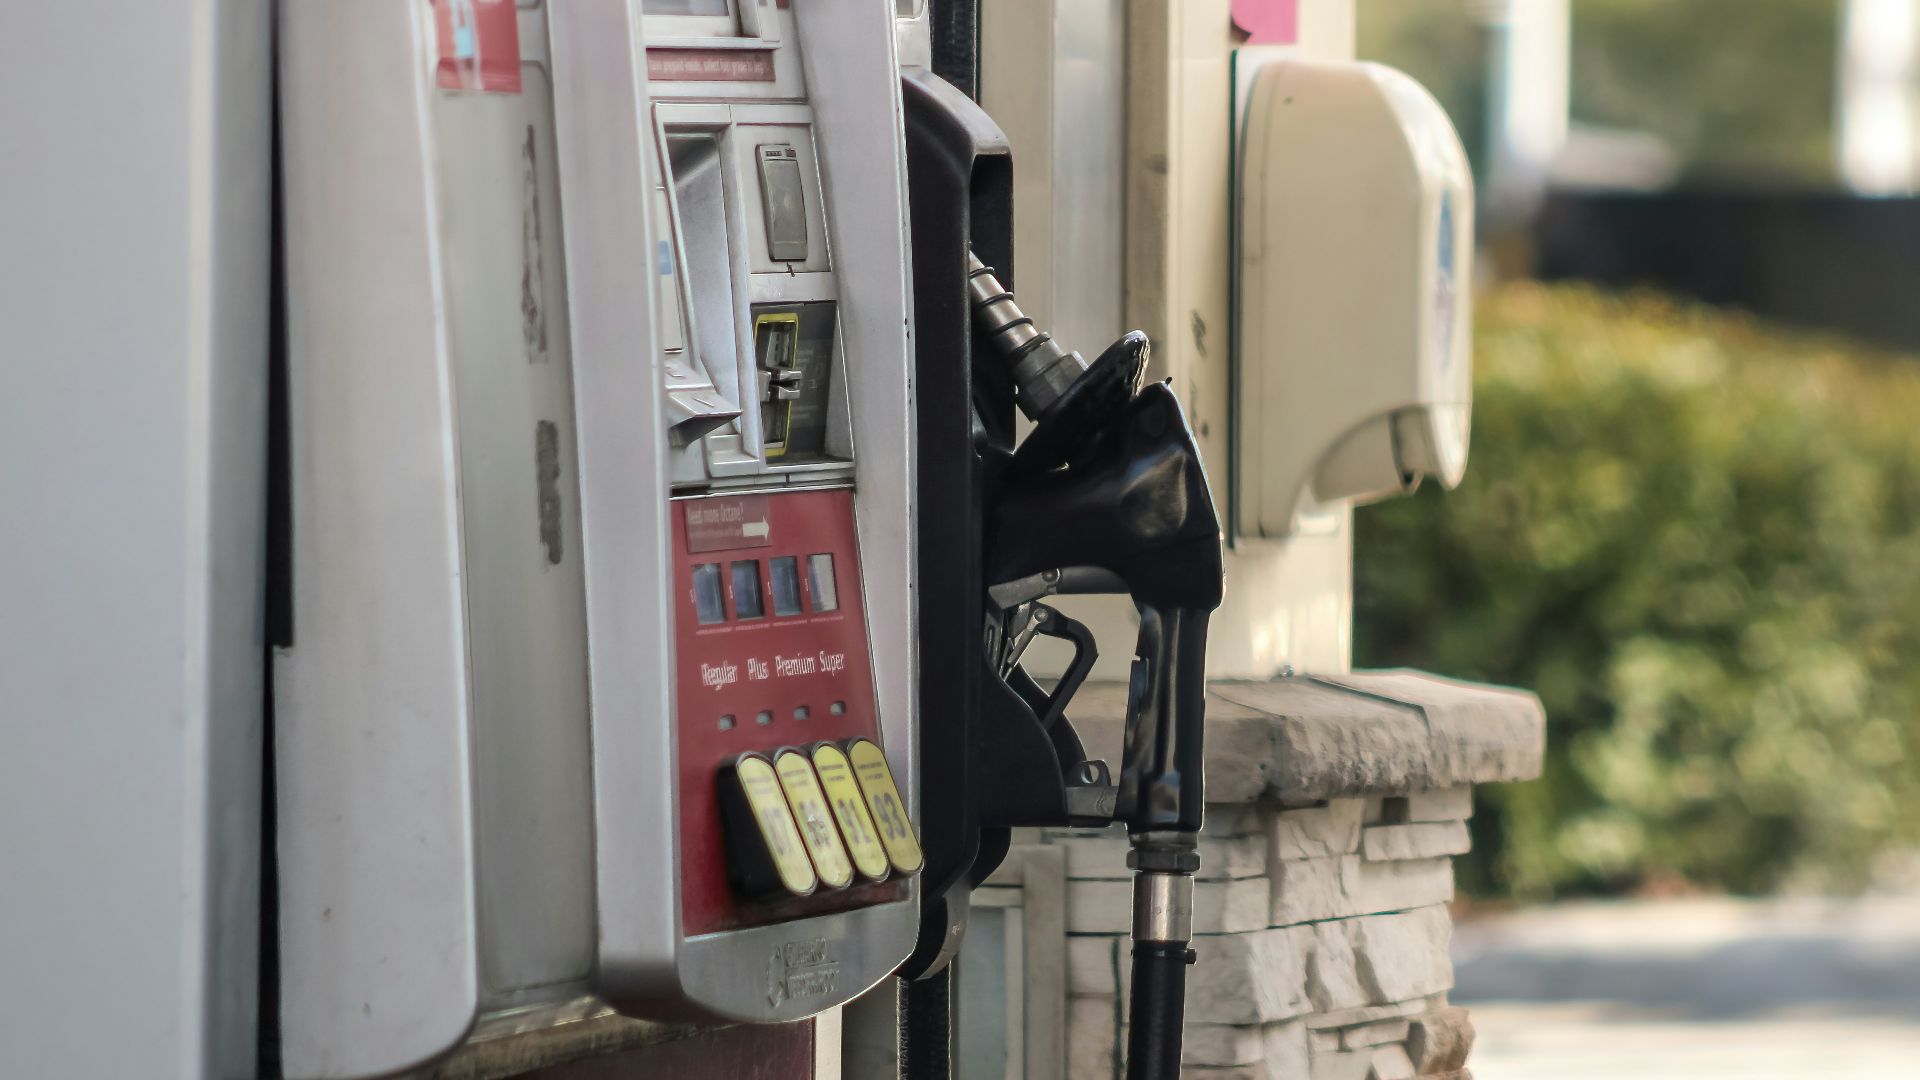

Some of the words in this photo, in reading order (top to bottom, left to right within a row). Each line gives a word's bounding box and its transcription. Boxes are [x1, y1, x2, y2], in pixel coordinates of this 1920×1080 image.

[701, 660, 738, 690] Regular
[747, 657, 769, 681] Plus
[775, 652, 815, 677] Premium
[819, 650, 845, 676] Super
[837, 798, 871, 844] 91
[872, 792, 906, 840] 93
